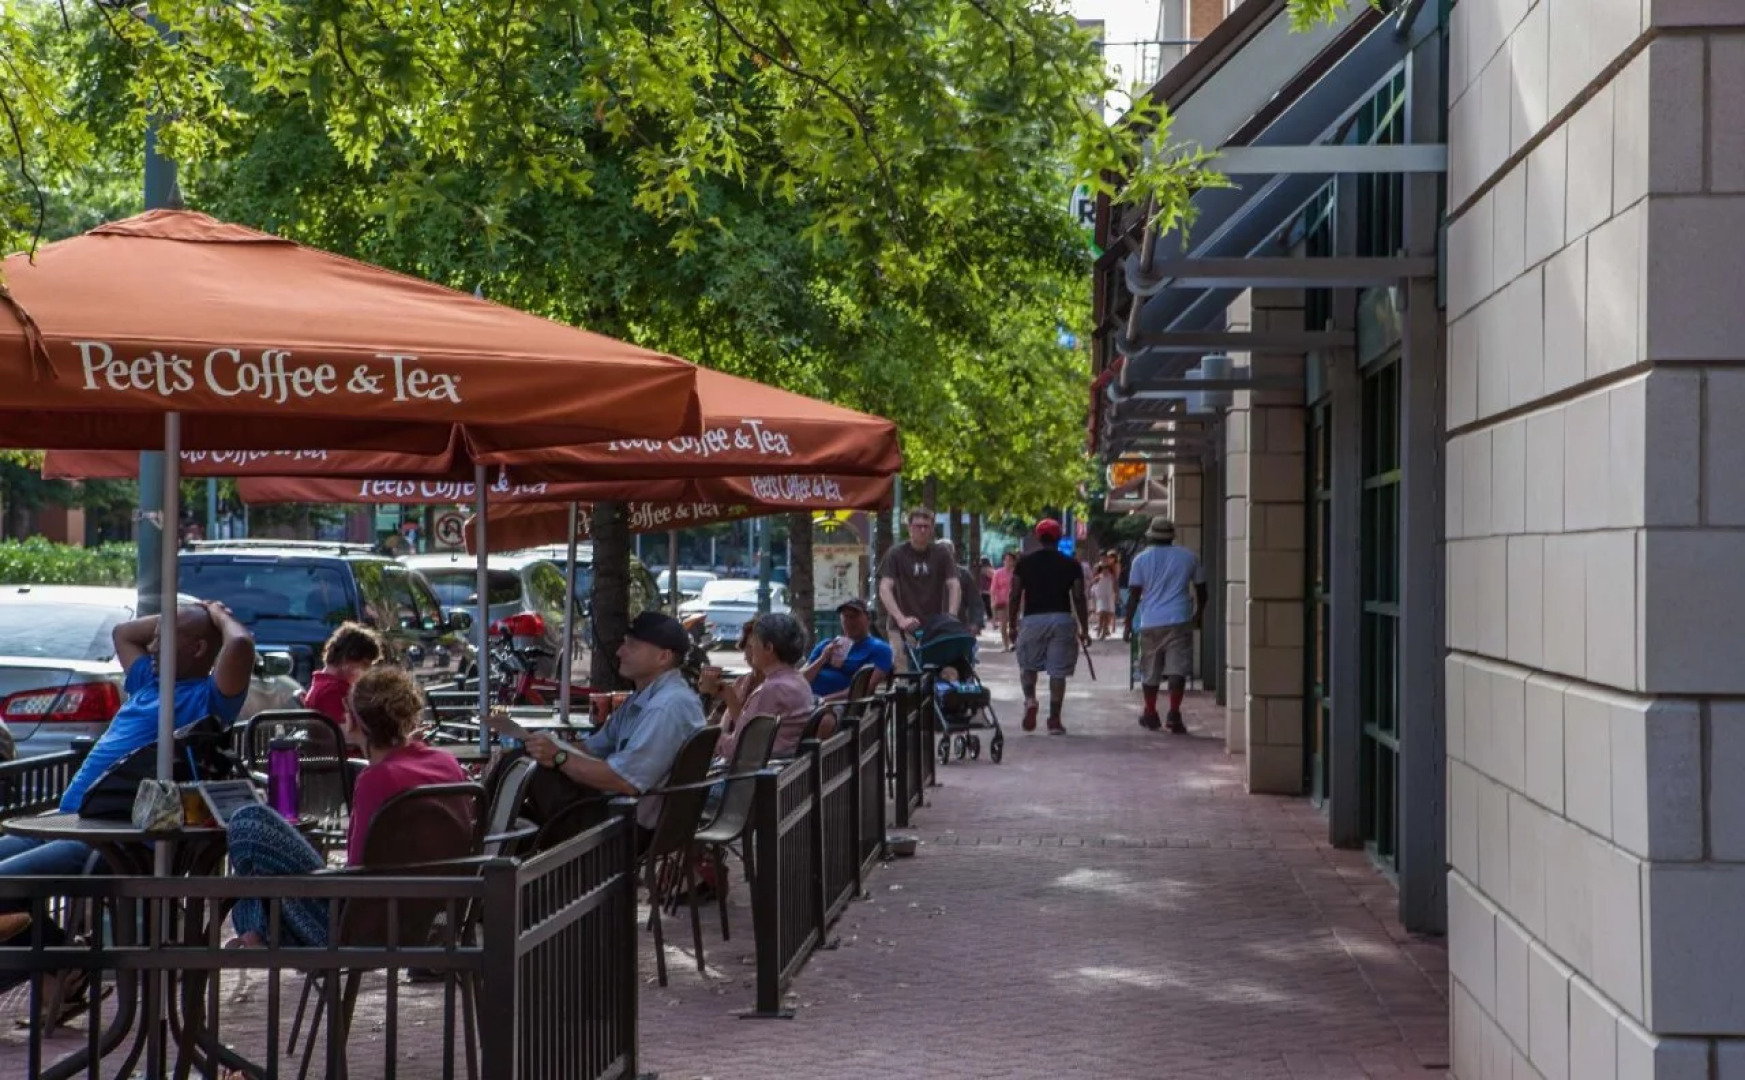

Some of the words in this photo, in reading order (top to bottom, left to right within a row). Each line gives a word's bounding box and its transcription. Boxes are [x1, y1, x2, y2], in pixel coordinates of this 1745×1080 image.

[204, 348, 338, 404] Coffee
[347, 364, 385, 394] &
[734, 428, 753, 450] &
[741, 419, 792, 456] Tea
